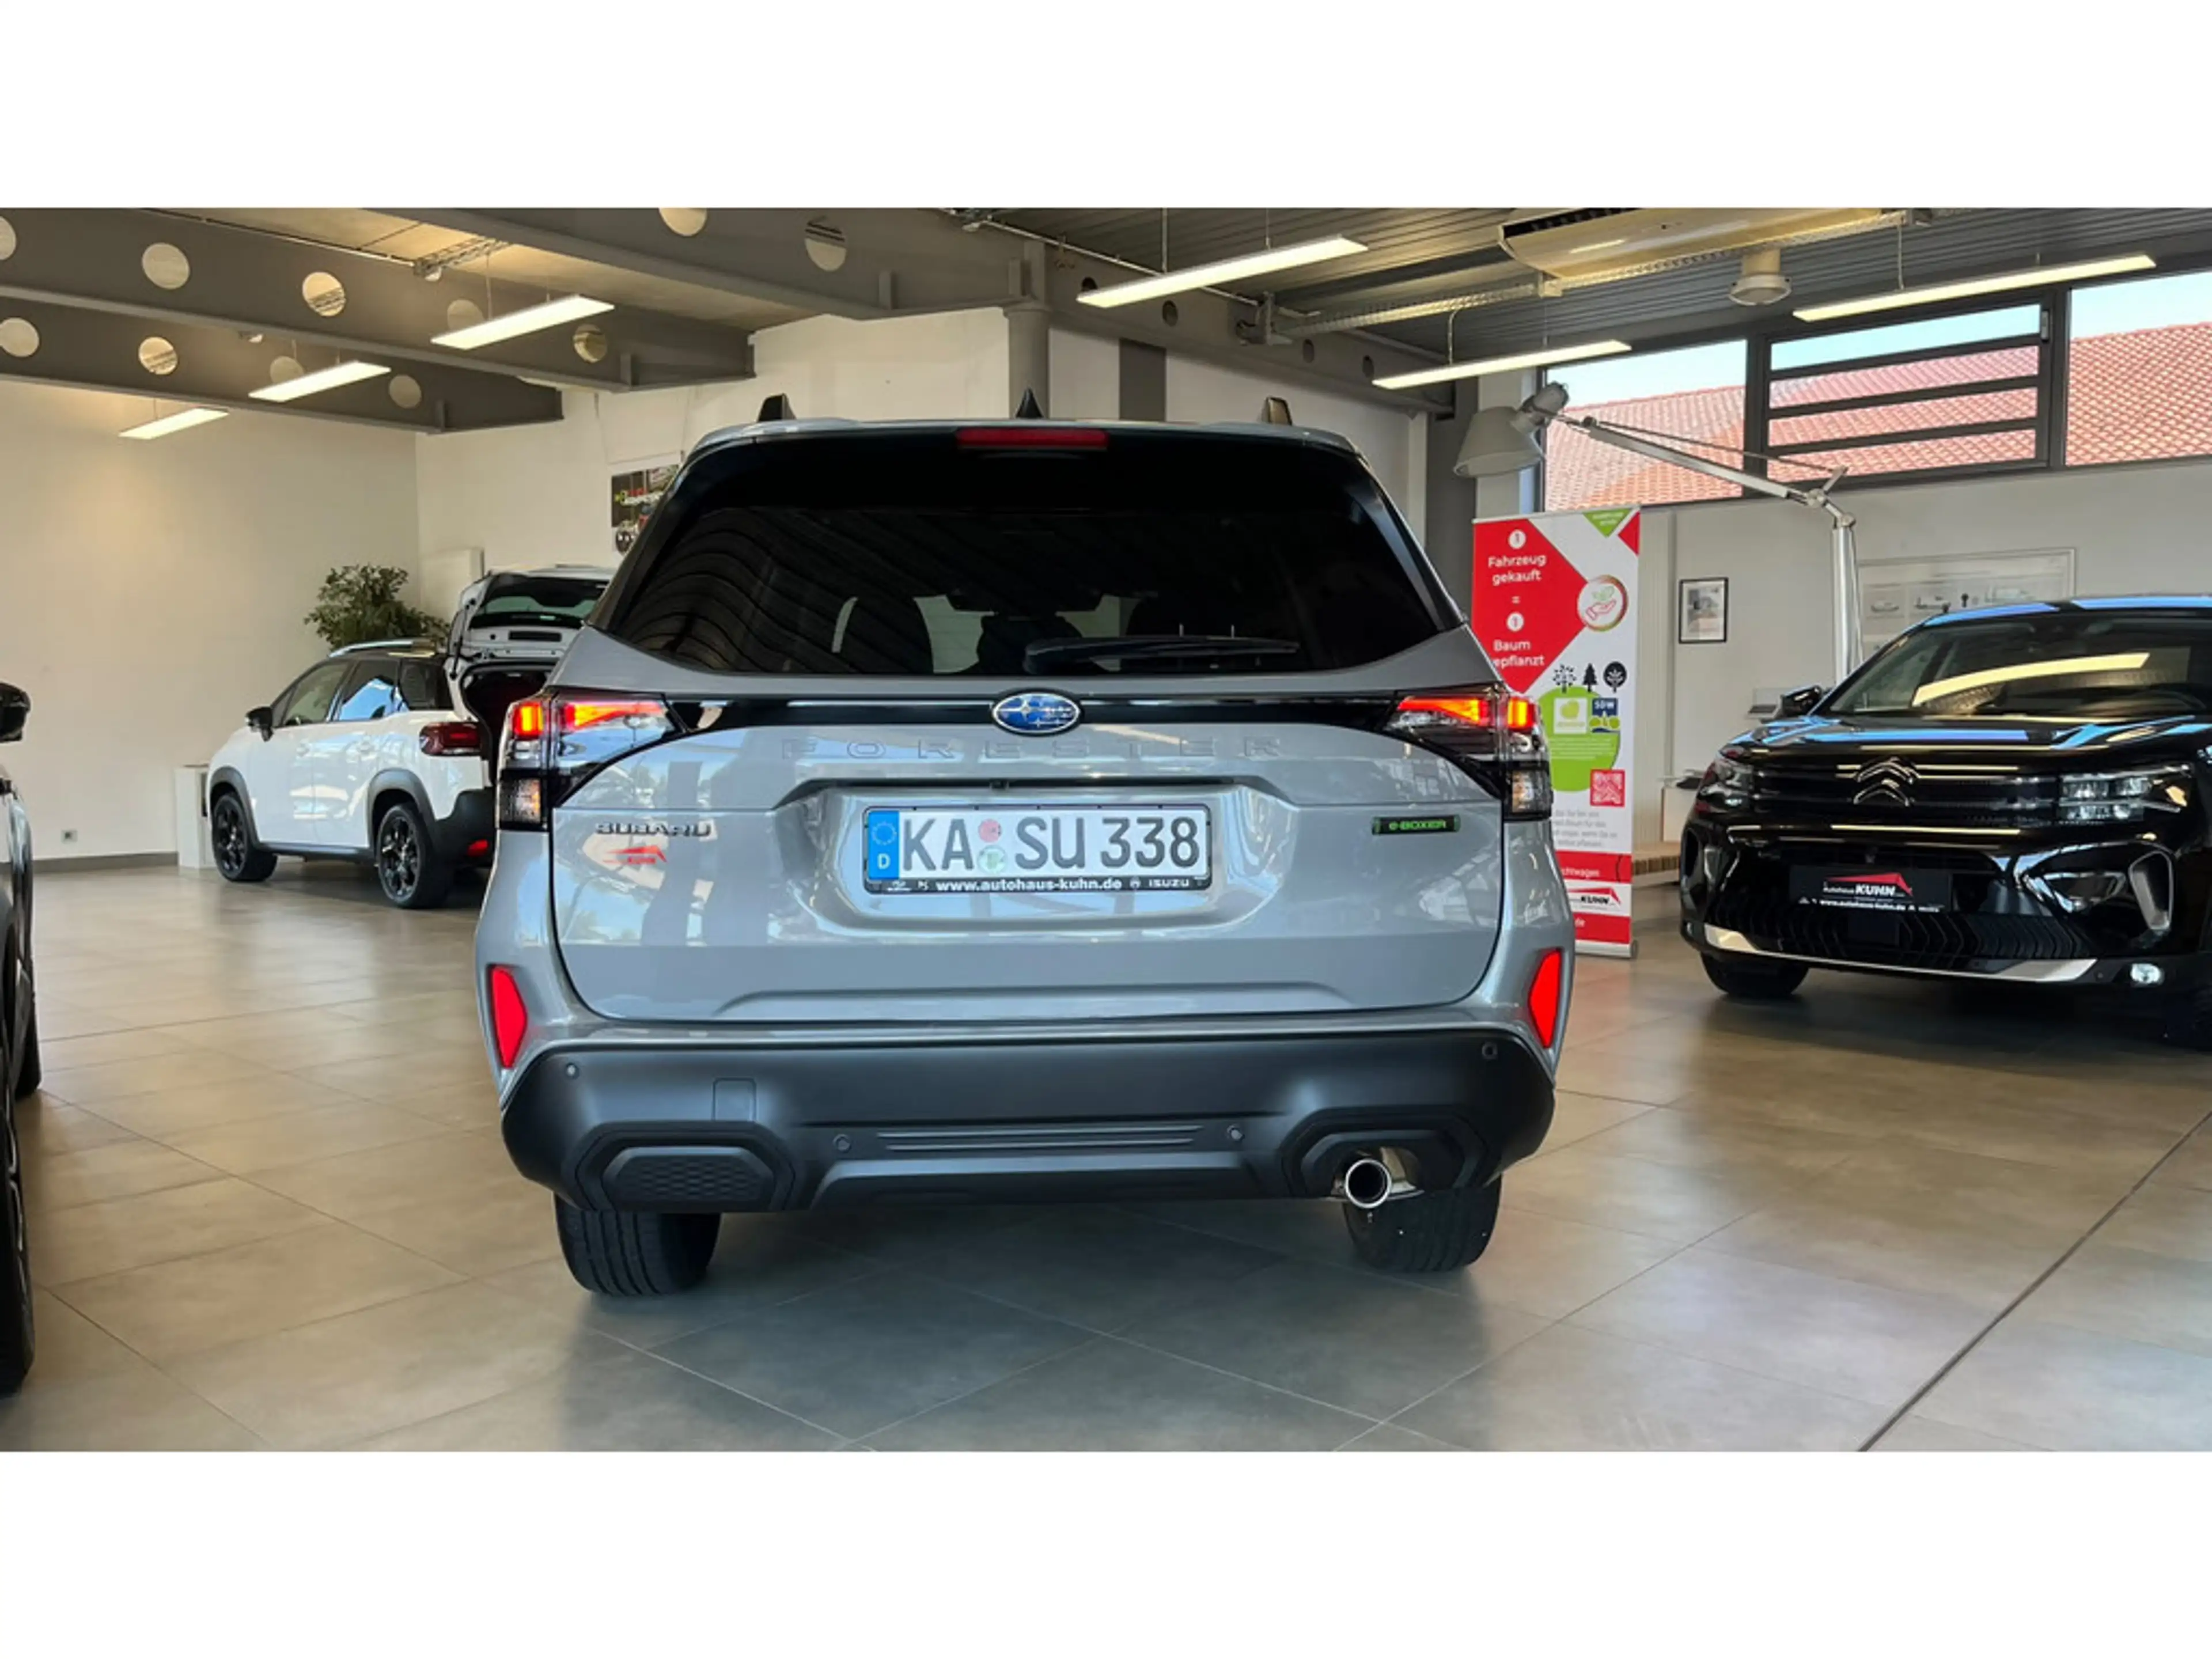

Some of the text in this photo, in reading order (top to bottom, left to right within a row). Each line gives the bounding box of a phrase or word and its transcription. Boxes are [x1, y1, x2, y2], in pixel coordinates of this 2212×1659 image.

[1488, 555, 1547, 568] Fahrzeug
[1492, 568, 1542, 586] gekauft
[1493, 639, 1531, 652] Baum
[781, 735, 1282, 760] FORESTER
[596, 821, 712, 836] SUBARU
[903, 816, 1200, 871] KA SU 338
[877, 853, 891, 870] D
[935, 878, 1122, 891] www.autohaus-kuhn.de
[1149, 878, 1190, 887] ISUZU
[1855, 884, 1896, 896] KUHN
